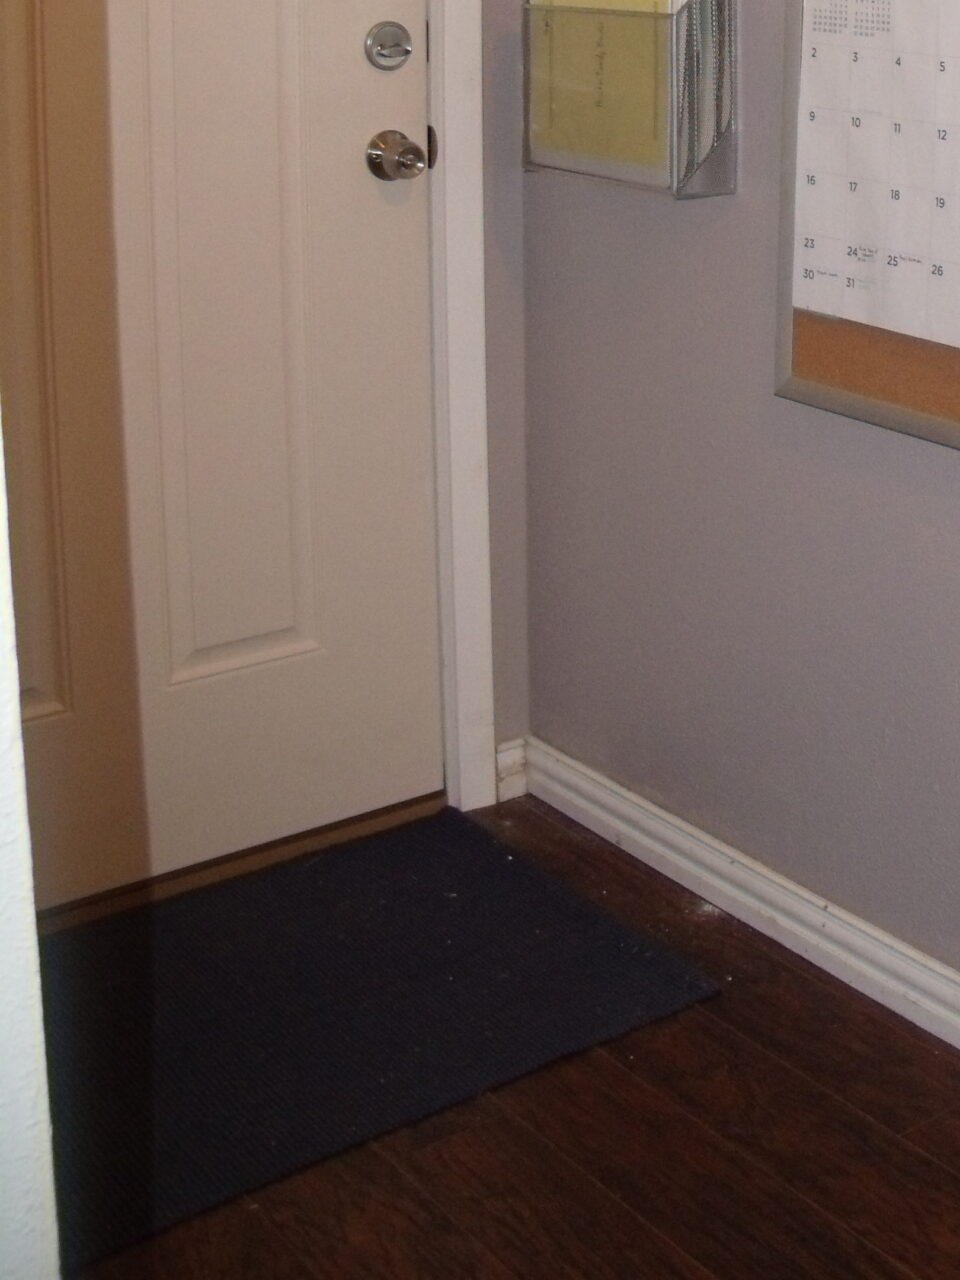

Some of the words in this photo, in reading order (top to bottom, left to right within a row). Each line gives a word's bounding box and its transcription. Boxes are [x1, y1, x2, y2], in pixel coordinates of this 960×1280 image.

[811, 48, 817, 58] 2
[852, 52, 858, 62] 3
[895, 57, 901, 66] 4
[939, 61, 945, 72] 5
[809, 111, 815, 121] 9
[851, 117, 861, 128] 10
[894, 123, 901, 134] 11
[937, 129, 947, 140] 12
[806, 174, 816, 185] 16
[849, 182, 858, 192] 17
[890, 189, 900, 200] 18
[935, 197, 945, 208] 19
[804, 237, 815, 249] 23
[847, 246, 858, 257] 24
[887, 255, 898, 267] 25
[931, 264, 944, 276] 26
[803, 268, 815, 279] 30
[846, 277, 855, 288] 31
